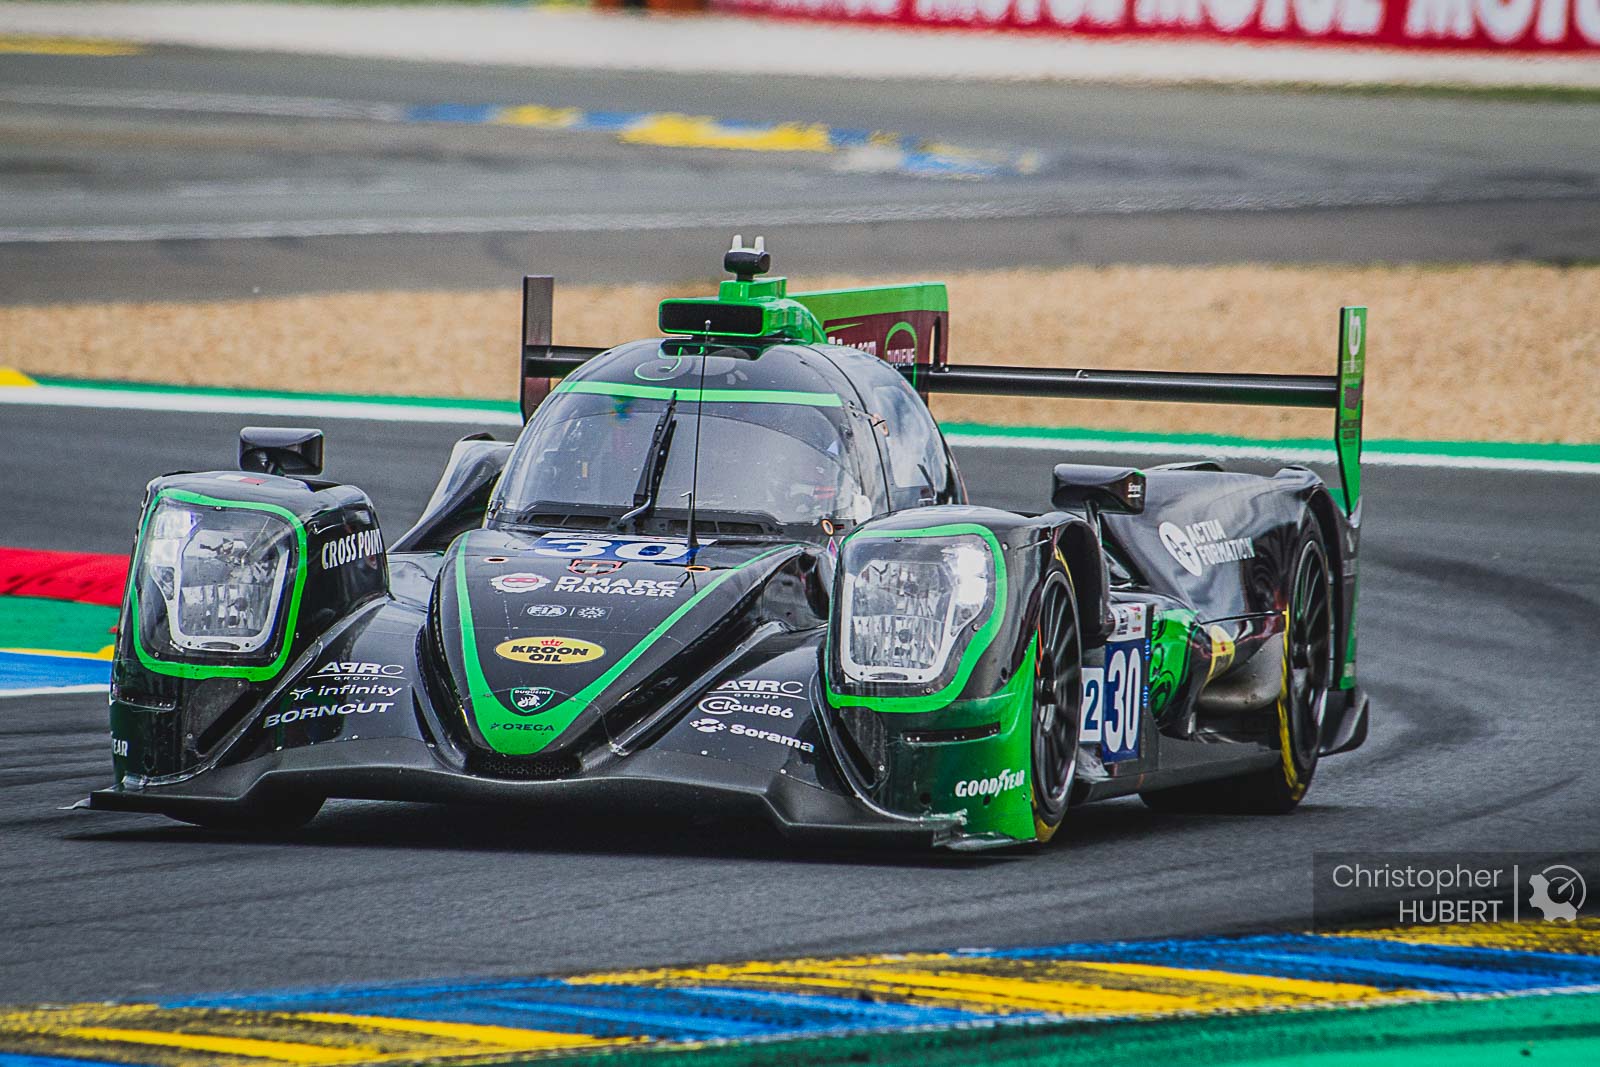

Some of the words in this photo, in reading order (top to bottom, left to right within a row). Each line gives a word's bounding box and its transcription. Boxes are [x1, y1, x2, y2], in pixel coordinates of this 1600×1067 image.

[1185, 519, 1227, 547] ACTUA
[321, 533, 357, 570] CROSS
[535, 539, 690, 561] 30
[1197, 537, 1255, 566] FORMATION
[553, 584, 677, 598] MANAGER
[556, 576, 680, 590] DMARC
[527, 605, 566, 617] FIA
[510, 645, 589, 656] KROON
[528, 653, 562, 663] OIL
[318, 684, 402, 697] infinity
[1105, 648, 1142, 752] 30
[263, 702, 394, 729] BORNCUT
[699, 697, 794, 719] Cloud86
[502, 723, 555, 732] OREGA
[730, 724, 815, 753] Sorama
